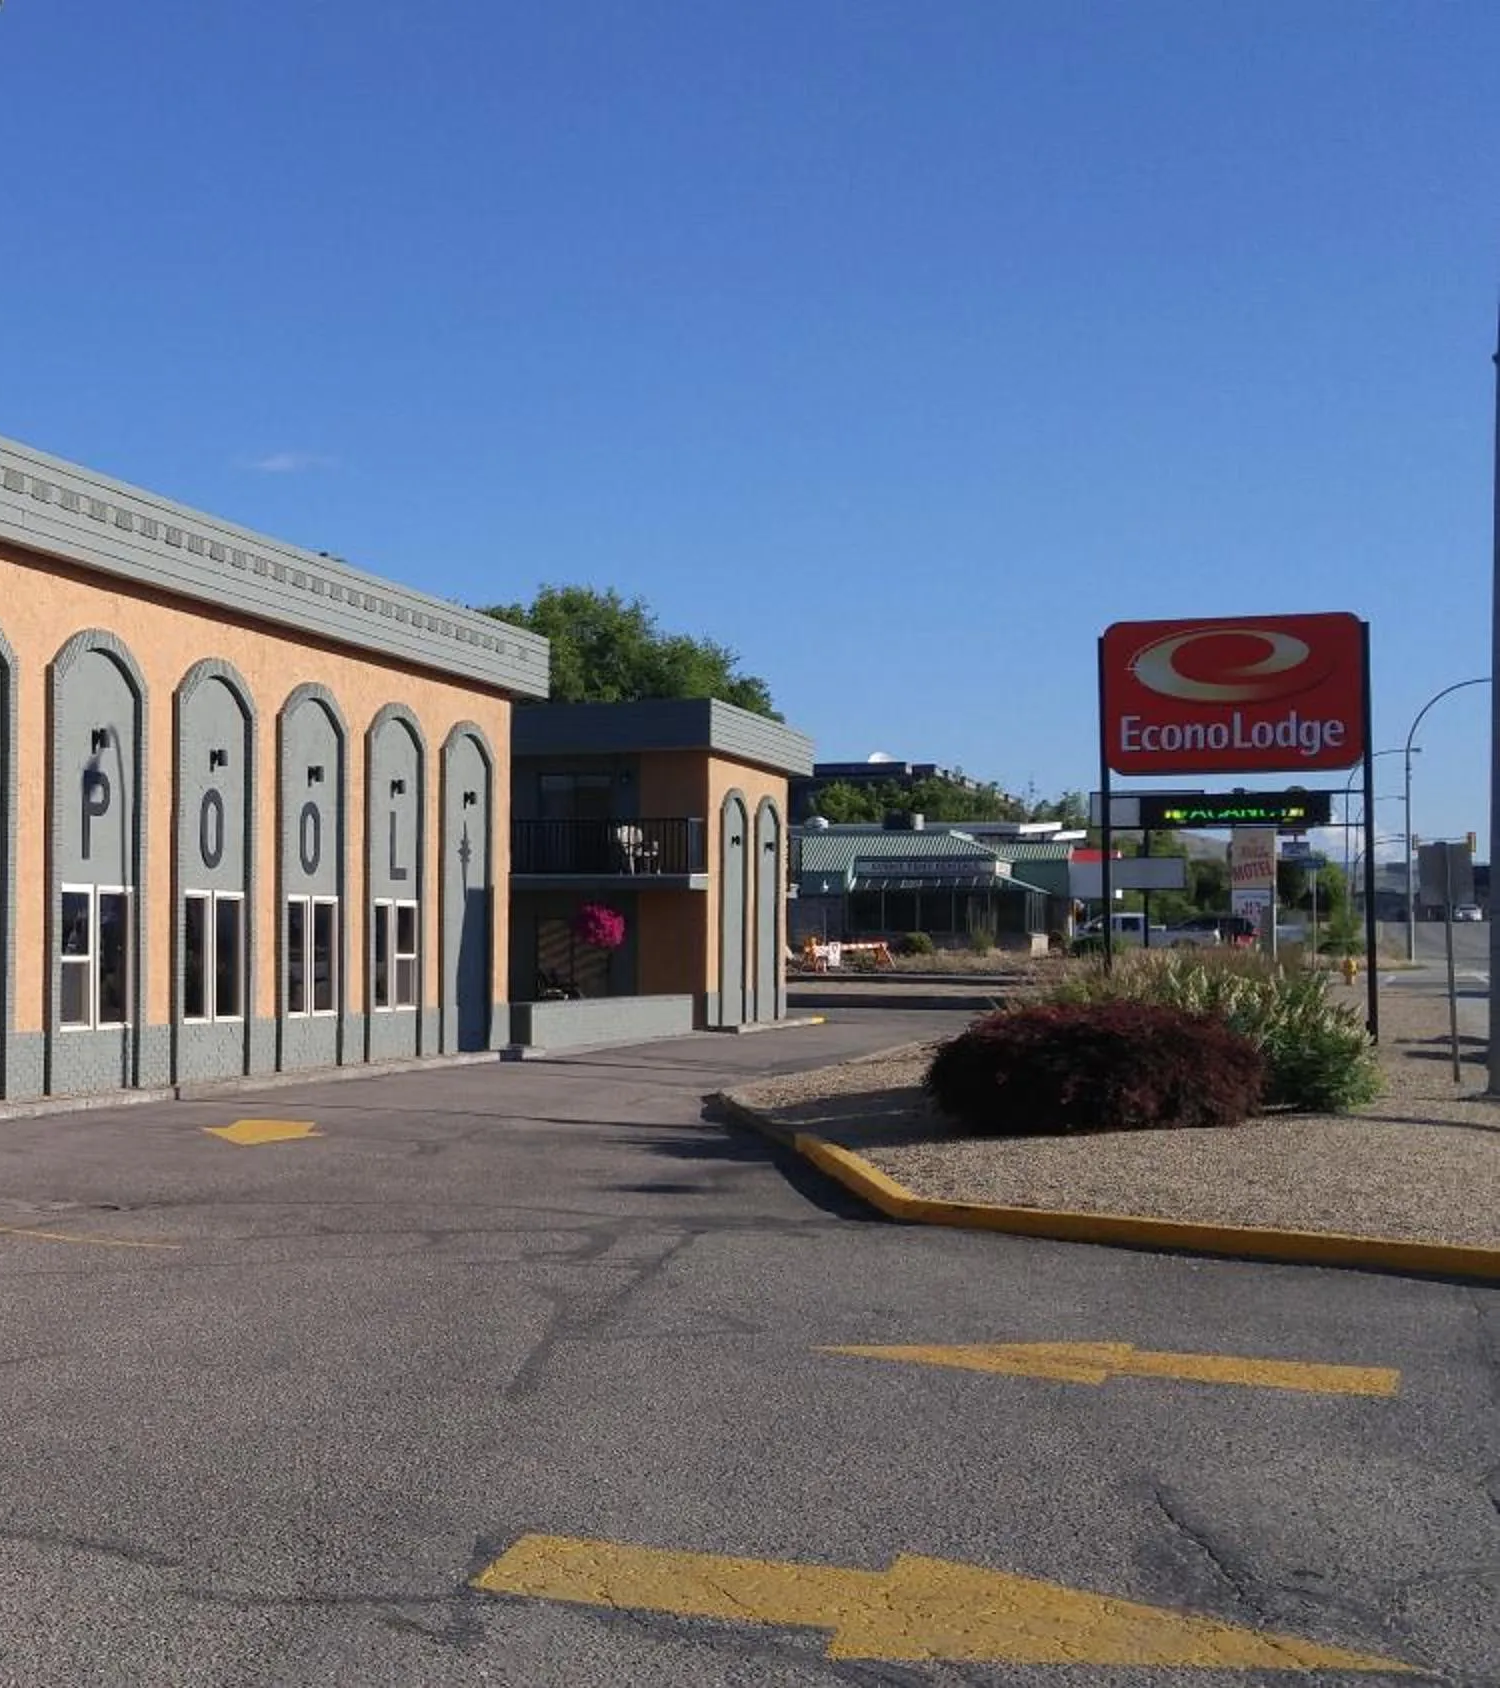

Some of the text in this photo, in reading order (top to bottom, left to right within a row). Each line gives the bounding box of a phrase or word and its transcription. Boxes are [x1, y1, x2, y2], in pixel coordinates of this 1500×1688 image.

[1120, 711, 1345, 755] EconoLodge
[81, 768, 407, 881] POOL
[1232, 859, 1274, 882] MOTEL
